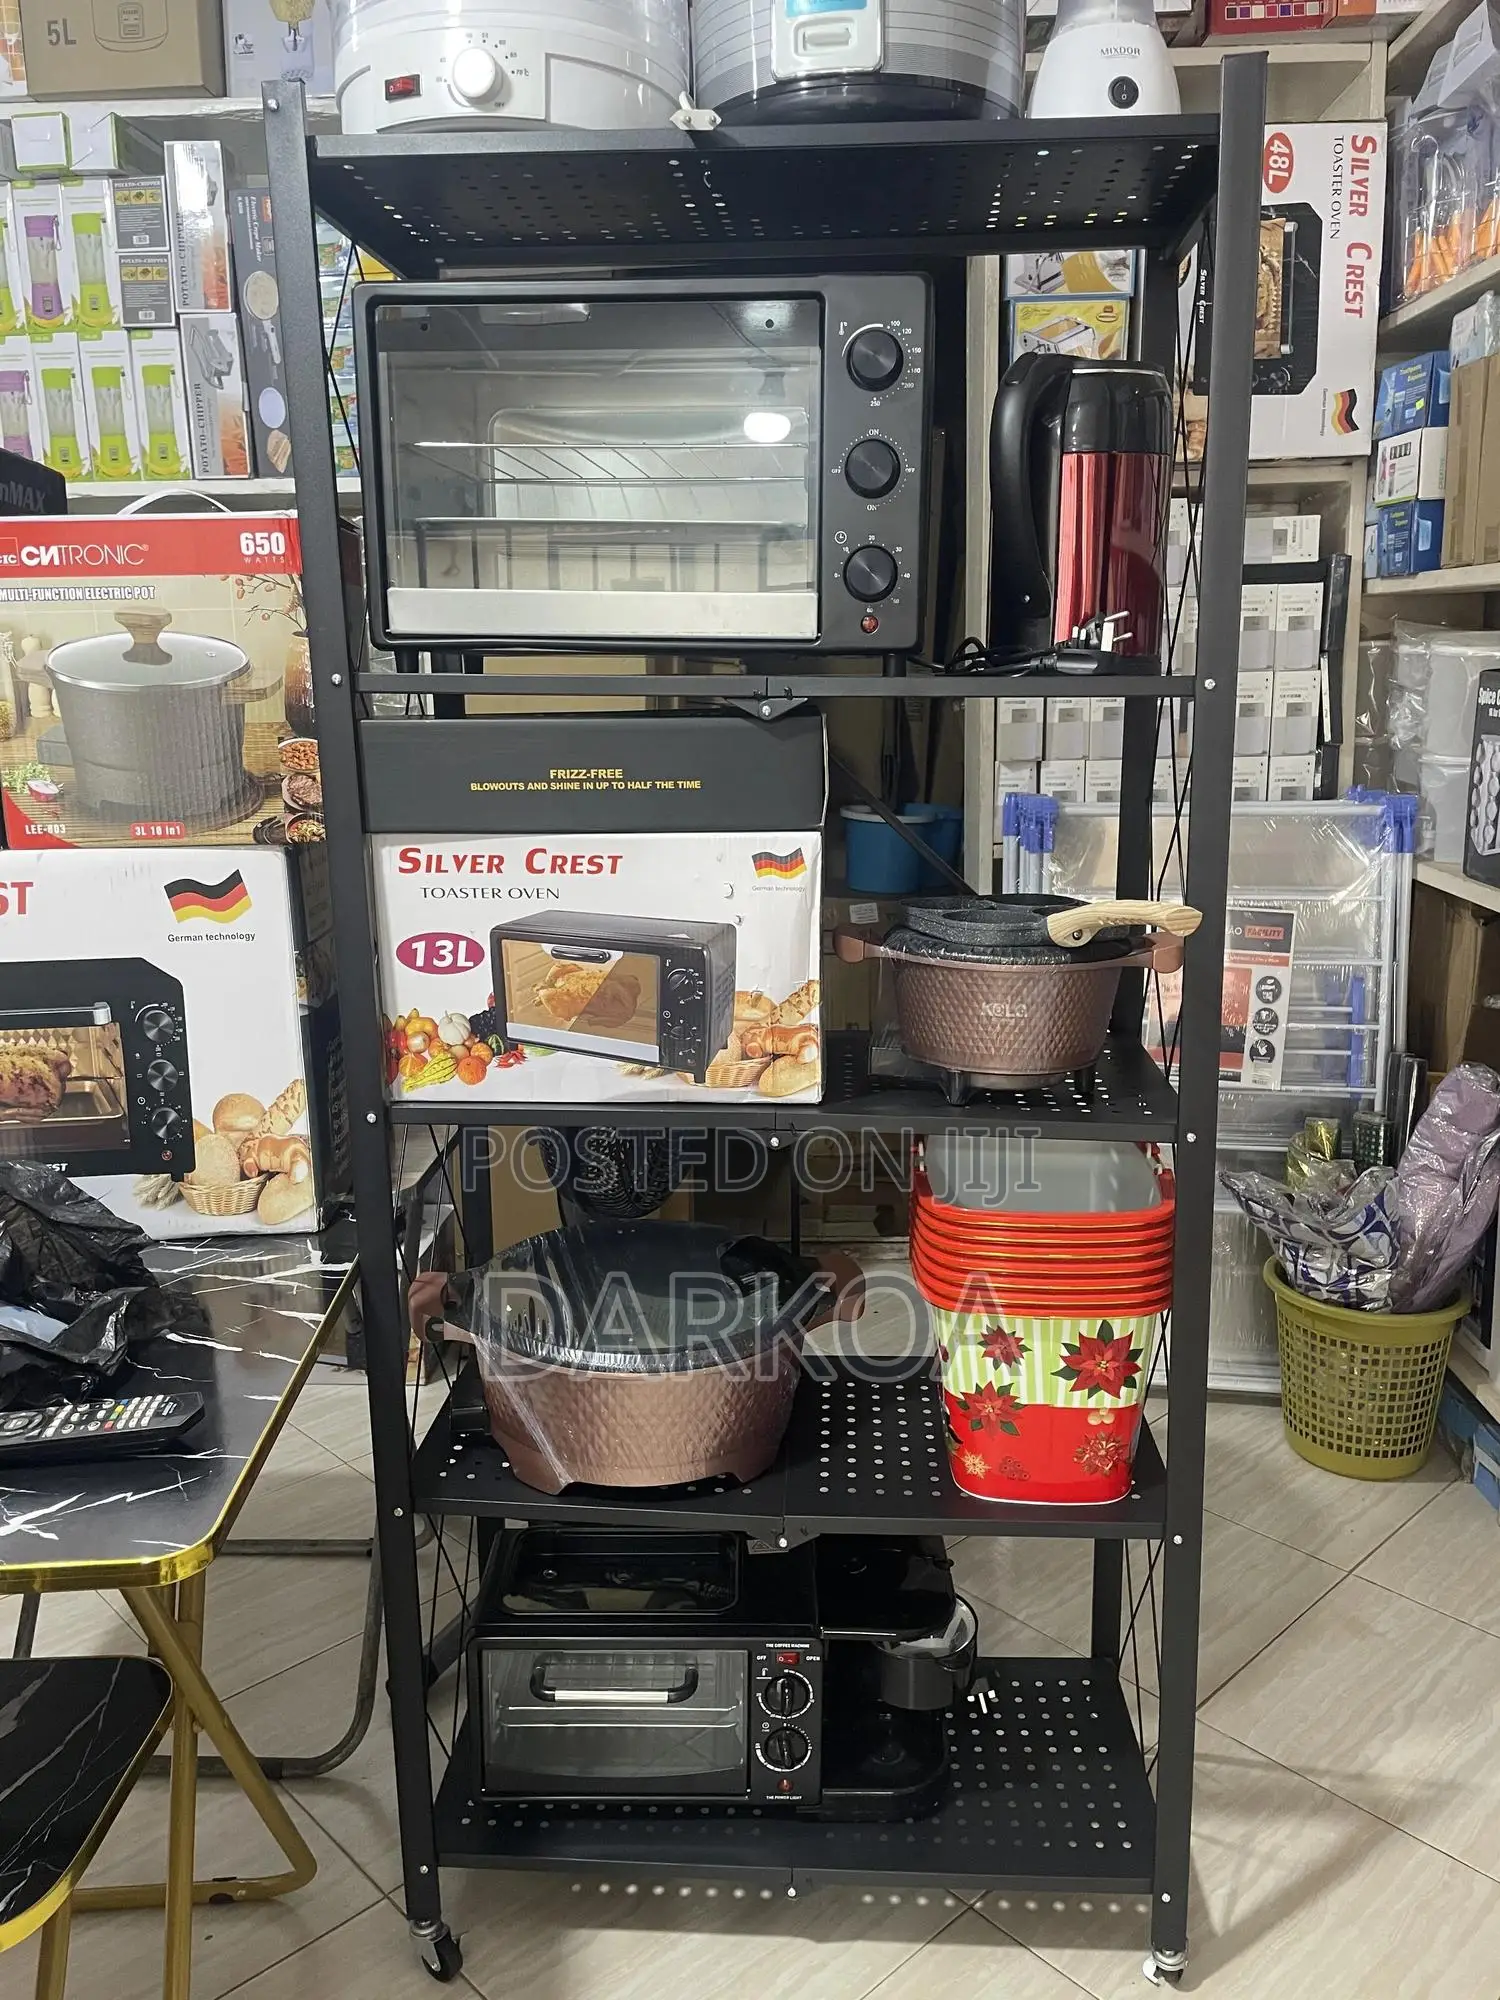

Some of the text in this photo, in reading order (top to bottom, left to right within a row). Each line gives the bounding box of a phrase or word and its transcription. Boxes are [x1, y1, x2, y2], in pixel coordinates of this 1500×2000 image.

[46, 17, 77, 46] 5L
[1100, 46, 1141, 56] MIXDOR
[1267, 138, 1290, 186] 48L
[1328, 135, 1345, 240] TOASTER OVEN
[1343, 135, 1377, 319] SILVER CREST
[240, 532, 286, 556] 650
[243, 556, 285, 564] WATTS
[0, 585, 156, 601] MULTI-FUNCTION ELECTRIC POT
[549, 768, 623, 779] FRIZZ-FREE
[470, 780, 702, 791] BLOWOUTS AND SHINE IN UP TO HALF THE TIME
[135, 826, 147, 836] 3L
[398, 847, 624, 875] SILVER CREST
[420, 887, 560, 900] TOASTER OVEN
[168, 932, 256, 943] German technology
[411, 940, 475, 968] 13L
